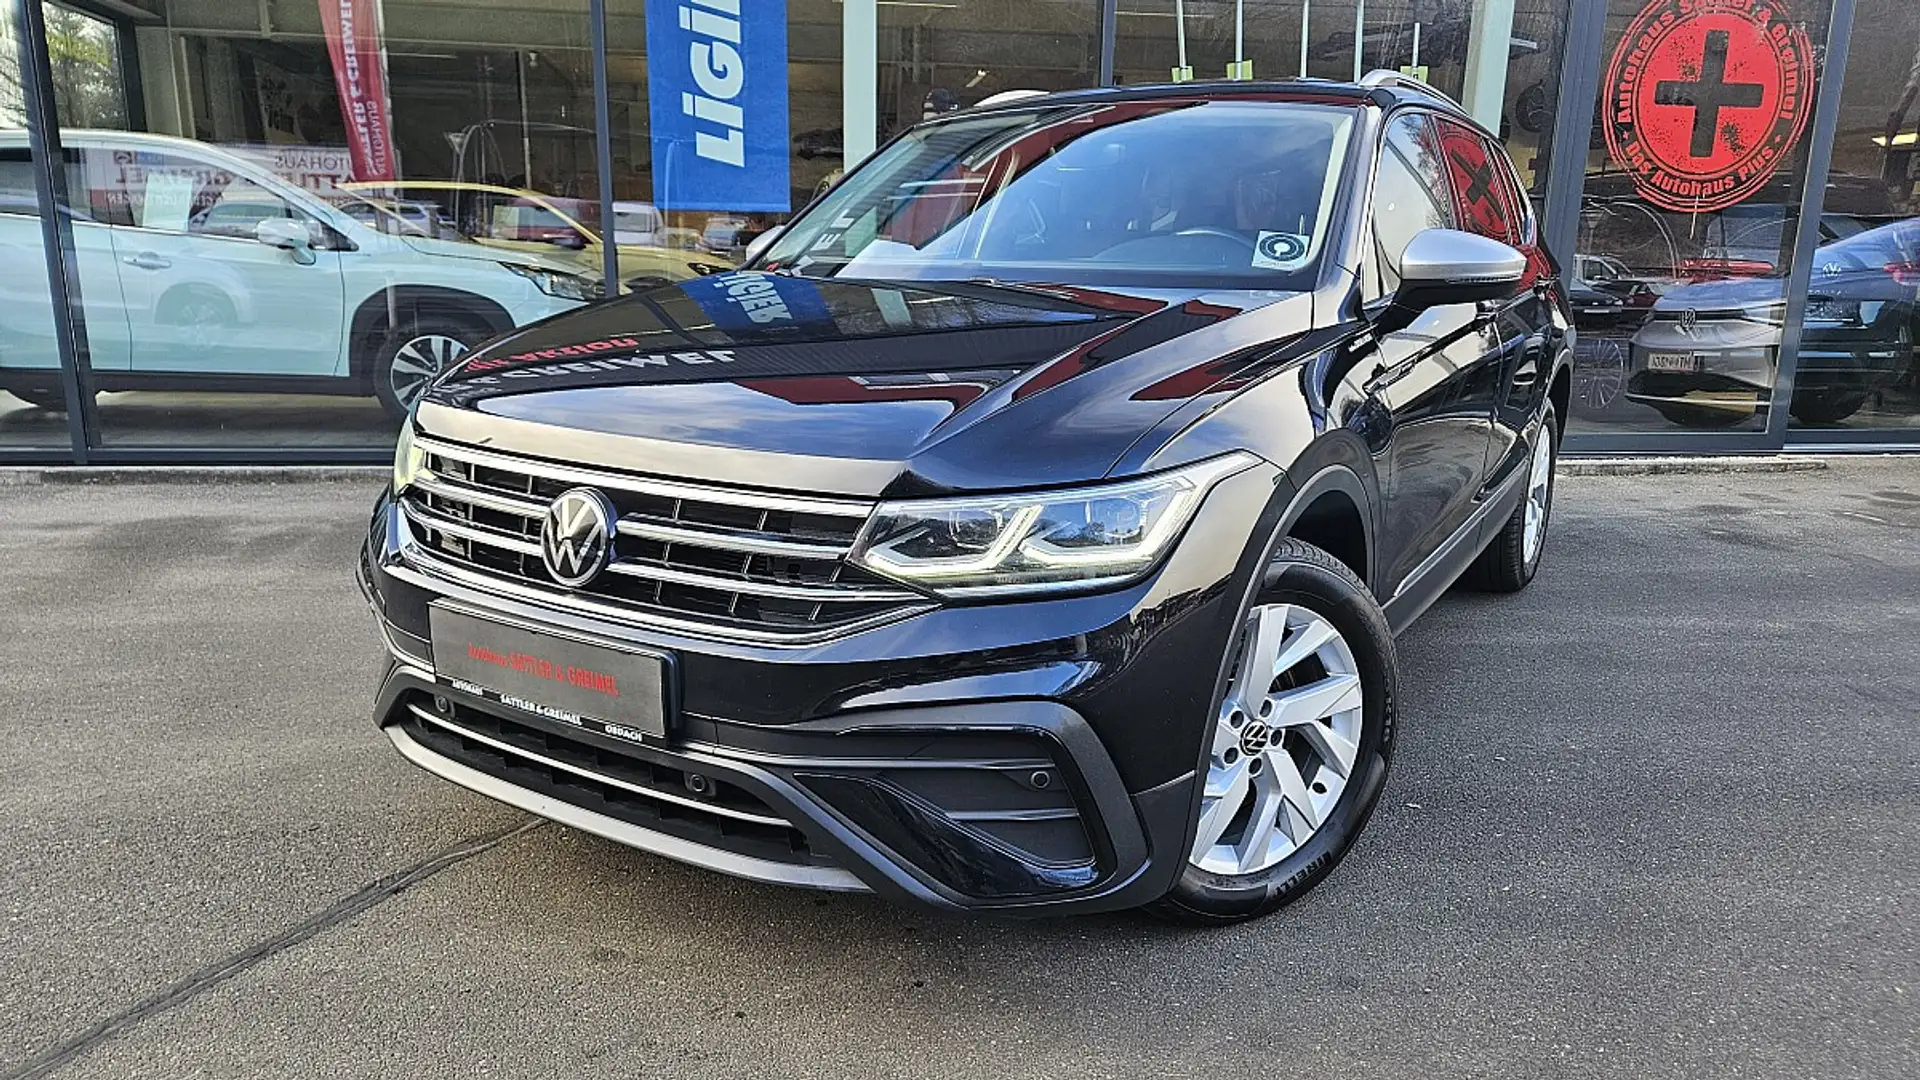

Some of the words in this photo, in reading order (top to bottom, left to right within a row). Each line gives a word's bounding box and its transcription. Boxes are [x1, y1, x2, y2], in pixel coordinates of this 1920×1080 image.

[679, 0, 745, 168] LiGi
[1618, 9, 1675, 123] Autohaus
[1757, 7, 1772, 21] &
[1771, 23, 1800, 119] Greimel
[1626, 141, 1652, 174] Das
[1650, 173, 1736, 196] Autohaus
[1740, 147, 1775, 182] Plus
[500, 693, 536, 713] SATTLER
[604, 724, 643, 742] OBDACH
[1275, 851, 1332, 897] PIRELLI
